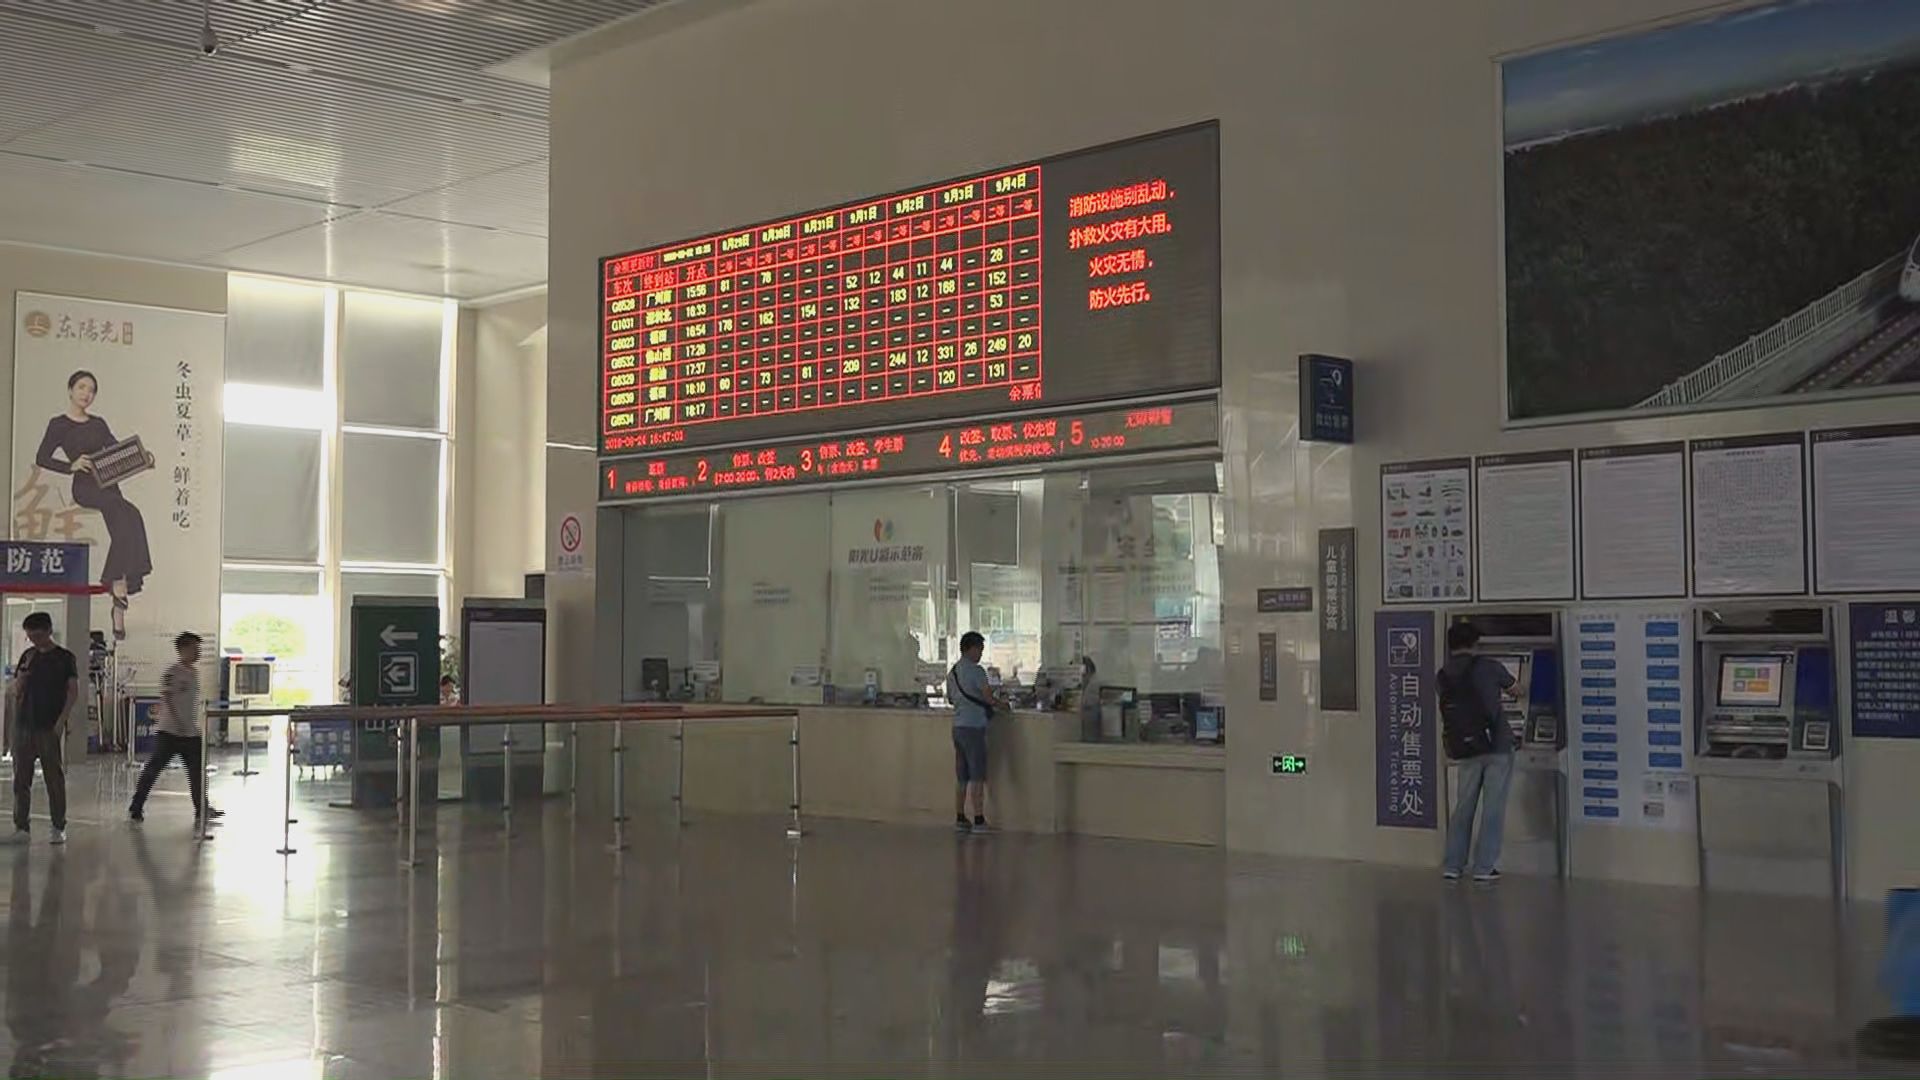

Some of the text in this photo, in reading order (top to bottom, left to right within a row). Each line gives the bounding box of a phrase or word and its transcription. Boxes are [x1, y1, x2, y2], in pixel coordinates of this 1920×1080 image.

[995, 172, 1027, 193] 9月4日
[895, 195, 924, 214] 9月2日
[943, 184, 974, 204] 9月3日
[804, 215, 834, 234] 8月31日
[849, 205, 877, 224] 9月1日
[762, 224, 791, 243] 8月30日
[1069, 213, 1172, 249] 扑救火灾有大用。
[722, 233, 750, 251] 8月29日
[845, 275, 858, 289] 52
[869, 271, 881, 285] 12
[892, 266, 905, 280] 44
[916, 262, 927, 276] 11
[940, 257, 953, 271] 44
[990, 247, 1004, 263] 28
[613, 278, 633, 295] 车次
[643, 270, 675, 288] 终到站
[686, 263, 708, 281] 开点
[686, 283, 707, 299] 15:56
[720, 279, 730, 293] 81
[685, 323, 706, 338] 16:54
[800, 304, 817, 318] 154
[843, 296, 860, 311] 132
[916, 284, 929, 299] 12
[988, 270, 1007, 286] 152
[989, 293, 1003, 308] 53
[1089, 281, 1150, 310] 防火先行。
[685, 381, 706, 395] 18:10
[760, 371, 771, 385] 73
[842, 359, 860, 374] 209
[889, 351, 907, 367] 244
[916, 348, 929, 363] 12
[937, 345, 954, 360] 331
[964, 341, 978, 357] 26
[987, 337, 1007, 353] 249
[1018, 333, 1032, 349] 20
[685, 361, 706, 376] 17:37
[685, 402, 706, 417] 18:17
[938, 369, 956, 385] 120
[988, 363, 1005, 378] 131
[1071, 420, 1084, 445] 5
[939, 435, 952, 458] 4
[697, 460, 708, 482] 2
[801, 450, 812, 471] 3
[607, 469, 615, 490] 1
[7, 547, 65, 574] 防范
[1401, 672, 1423, 816] 自动售票处
